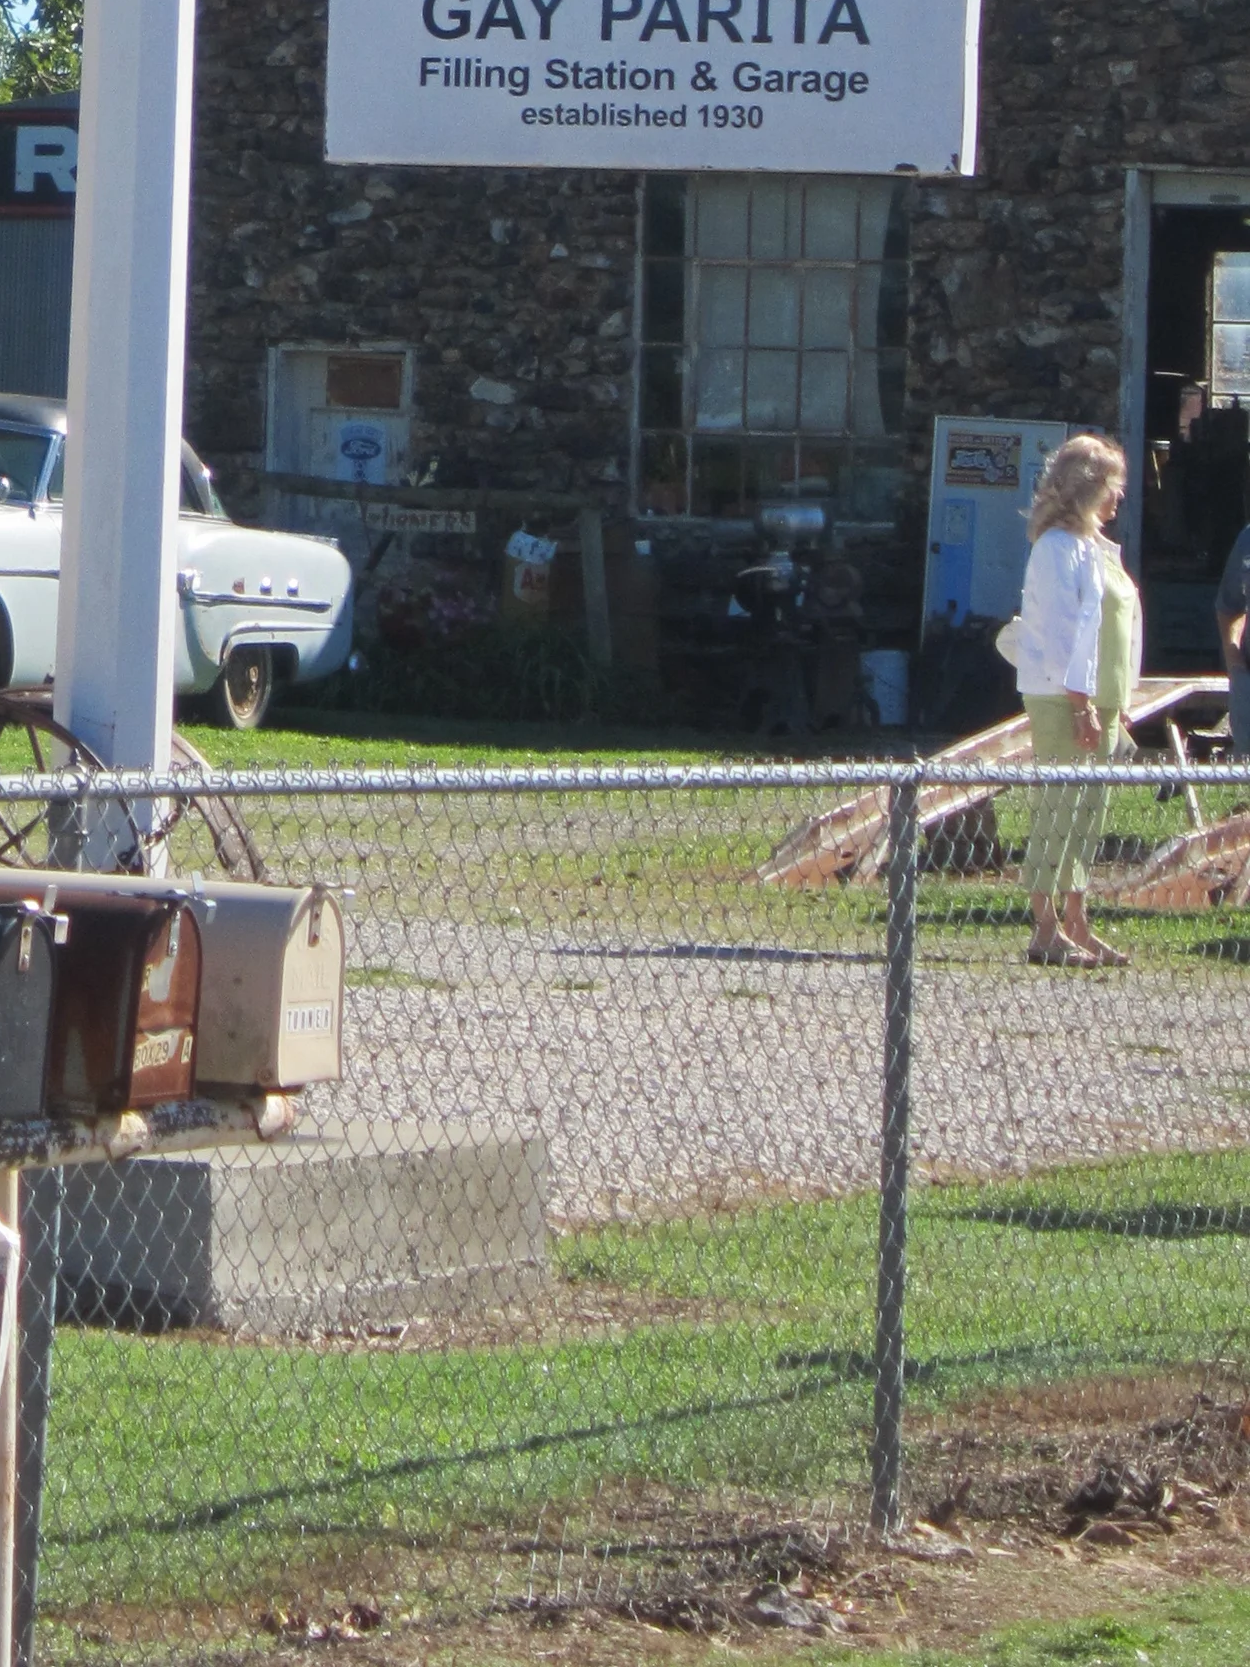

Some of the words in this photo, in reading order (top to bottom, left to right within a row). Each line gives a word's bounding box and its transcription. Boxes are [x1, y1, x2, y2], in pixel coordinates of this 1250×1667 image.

[419, 56, 530, 97] Filling
[544, 58, 675, 92] Station
[690, 61, 718, 92] &
[732, 62, 869, 102] Garage
[521, 103, 688, 128] established
[697, 105, 764, 129] 1930
